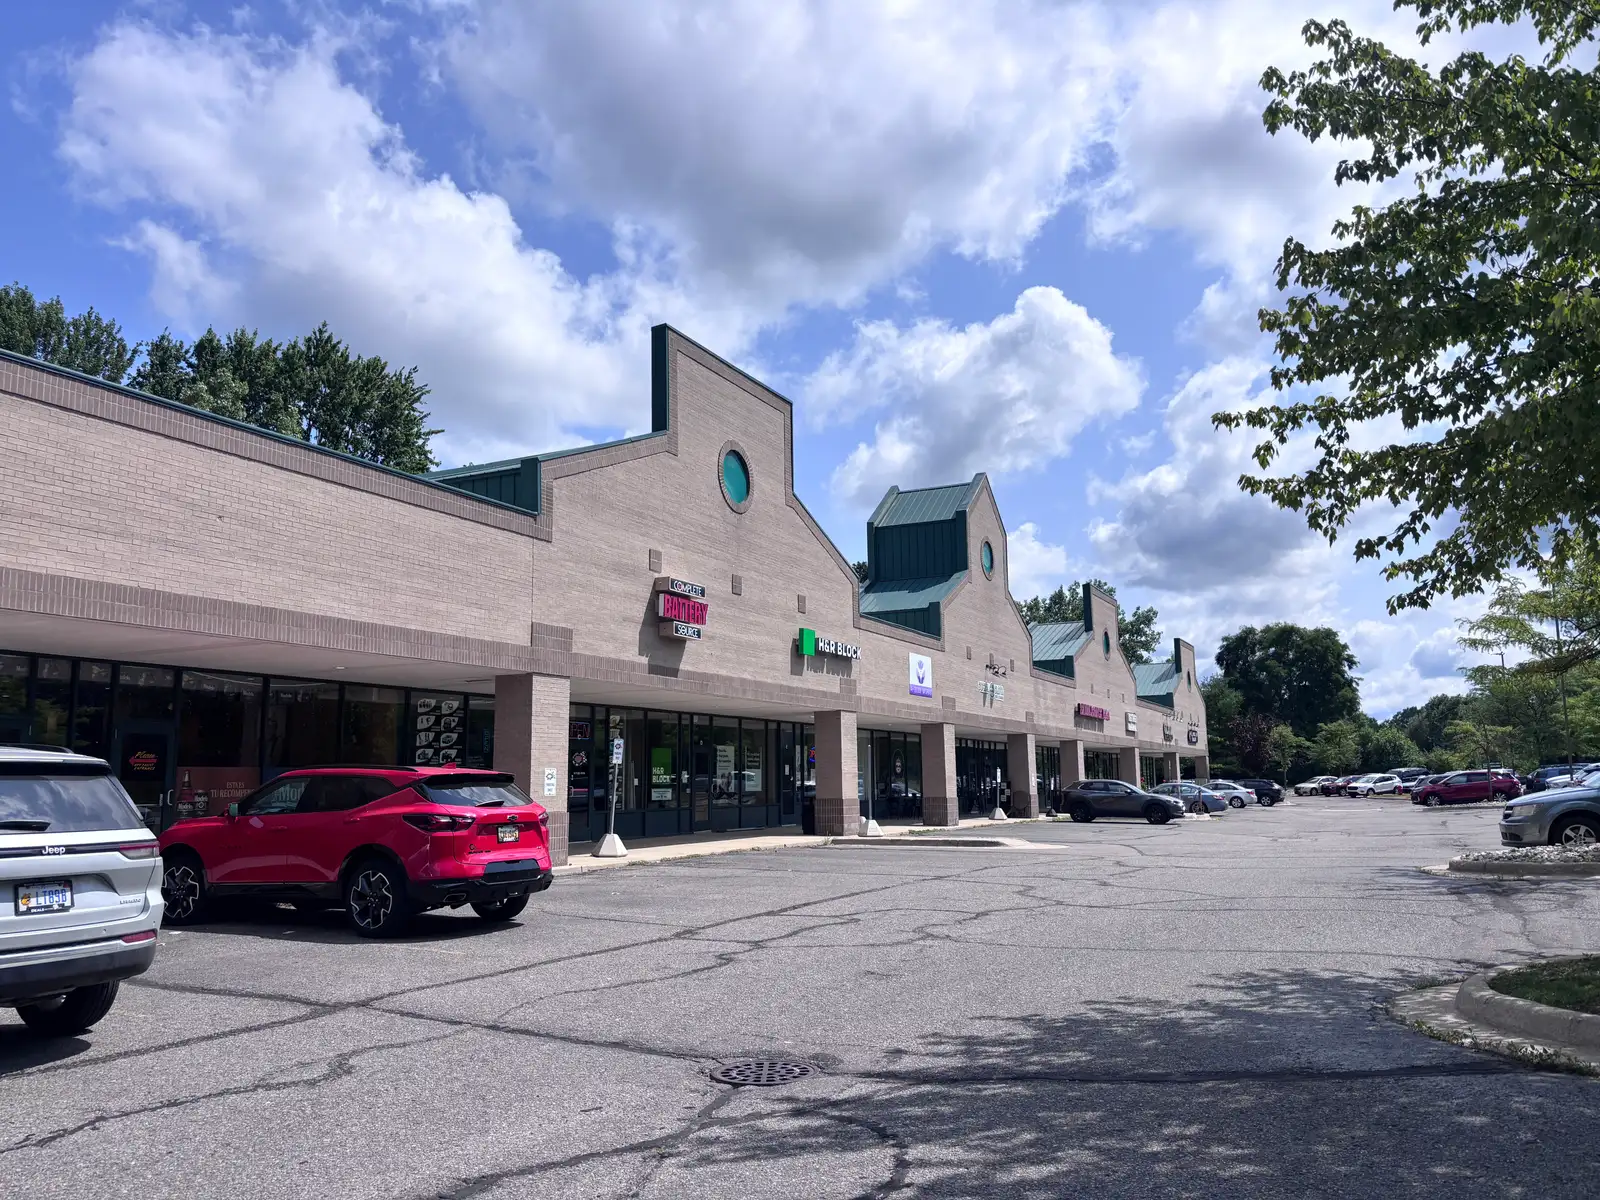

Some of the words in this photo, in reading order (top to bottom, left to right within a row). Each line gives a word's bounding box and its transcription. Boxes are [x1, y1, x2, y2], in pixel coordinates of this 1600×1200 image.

[673, 580, 702, 597] COMPLETE
[664, 593, 709, 625] BATTERY
[677, 625, 699, 638] SOURCE
[818, 638, 836, 654] H&R
[837, 642, 862, 660] BLOCK
[569, 723, 589, 738] PEN
[652, 767, 664, 775] H&R
[652, 775, 671, 783] BLOCK
[41, 846, 66, 856] Jeep
